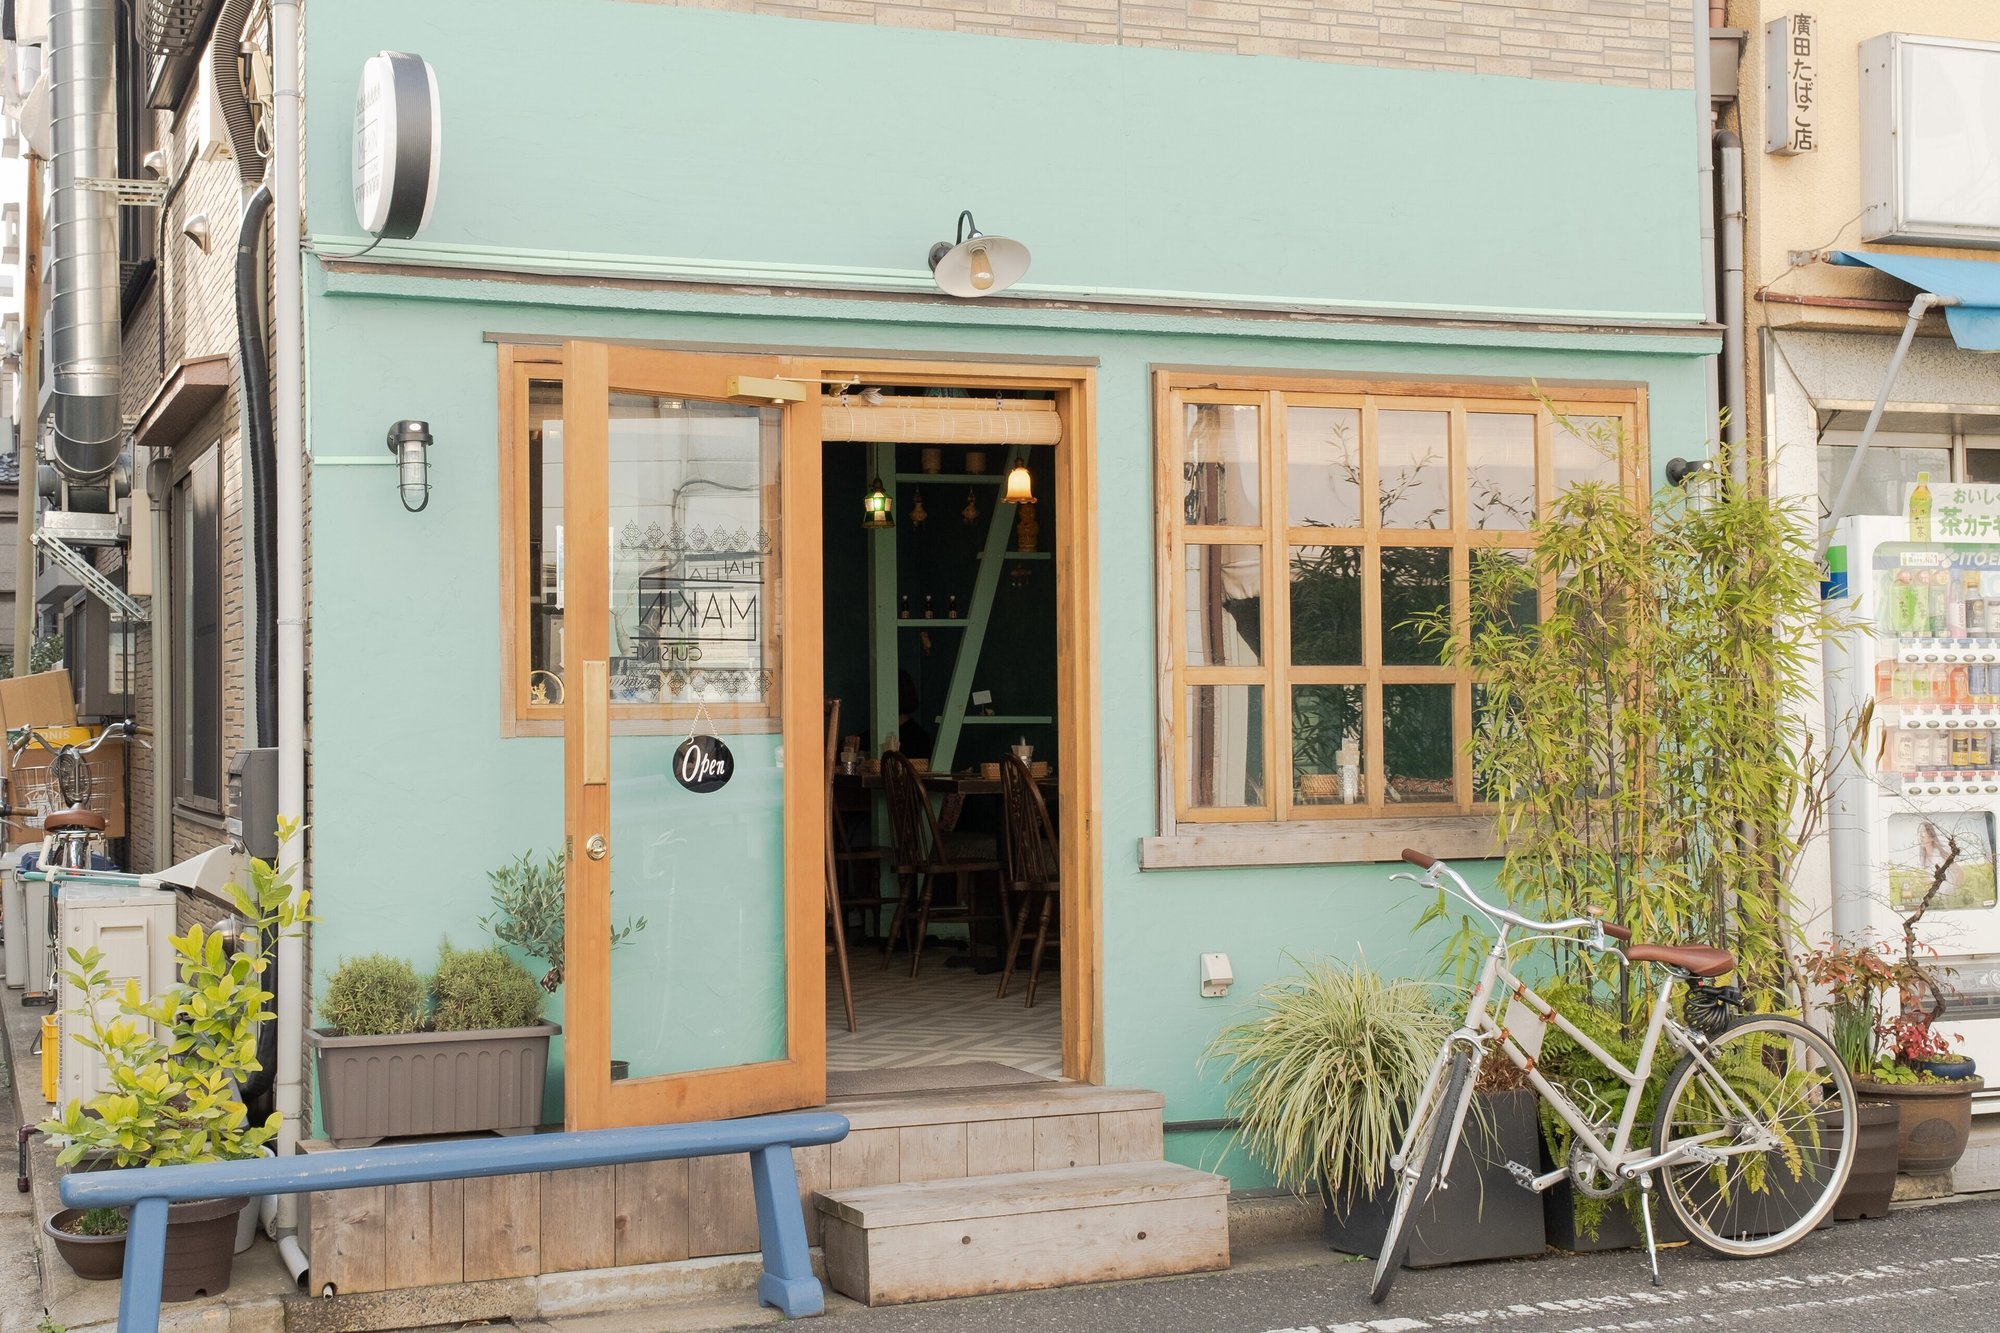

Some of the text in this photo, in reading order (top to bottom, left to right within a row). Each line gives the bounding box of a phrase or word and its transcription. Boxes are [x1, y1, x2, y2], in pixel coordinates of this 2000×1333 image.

[1792, 13, 1813, 151] 廣田たばこ店
[1959, 552, 1987, 567] ITO
[681, 744, 726, 783] Open
